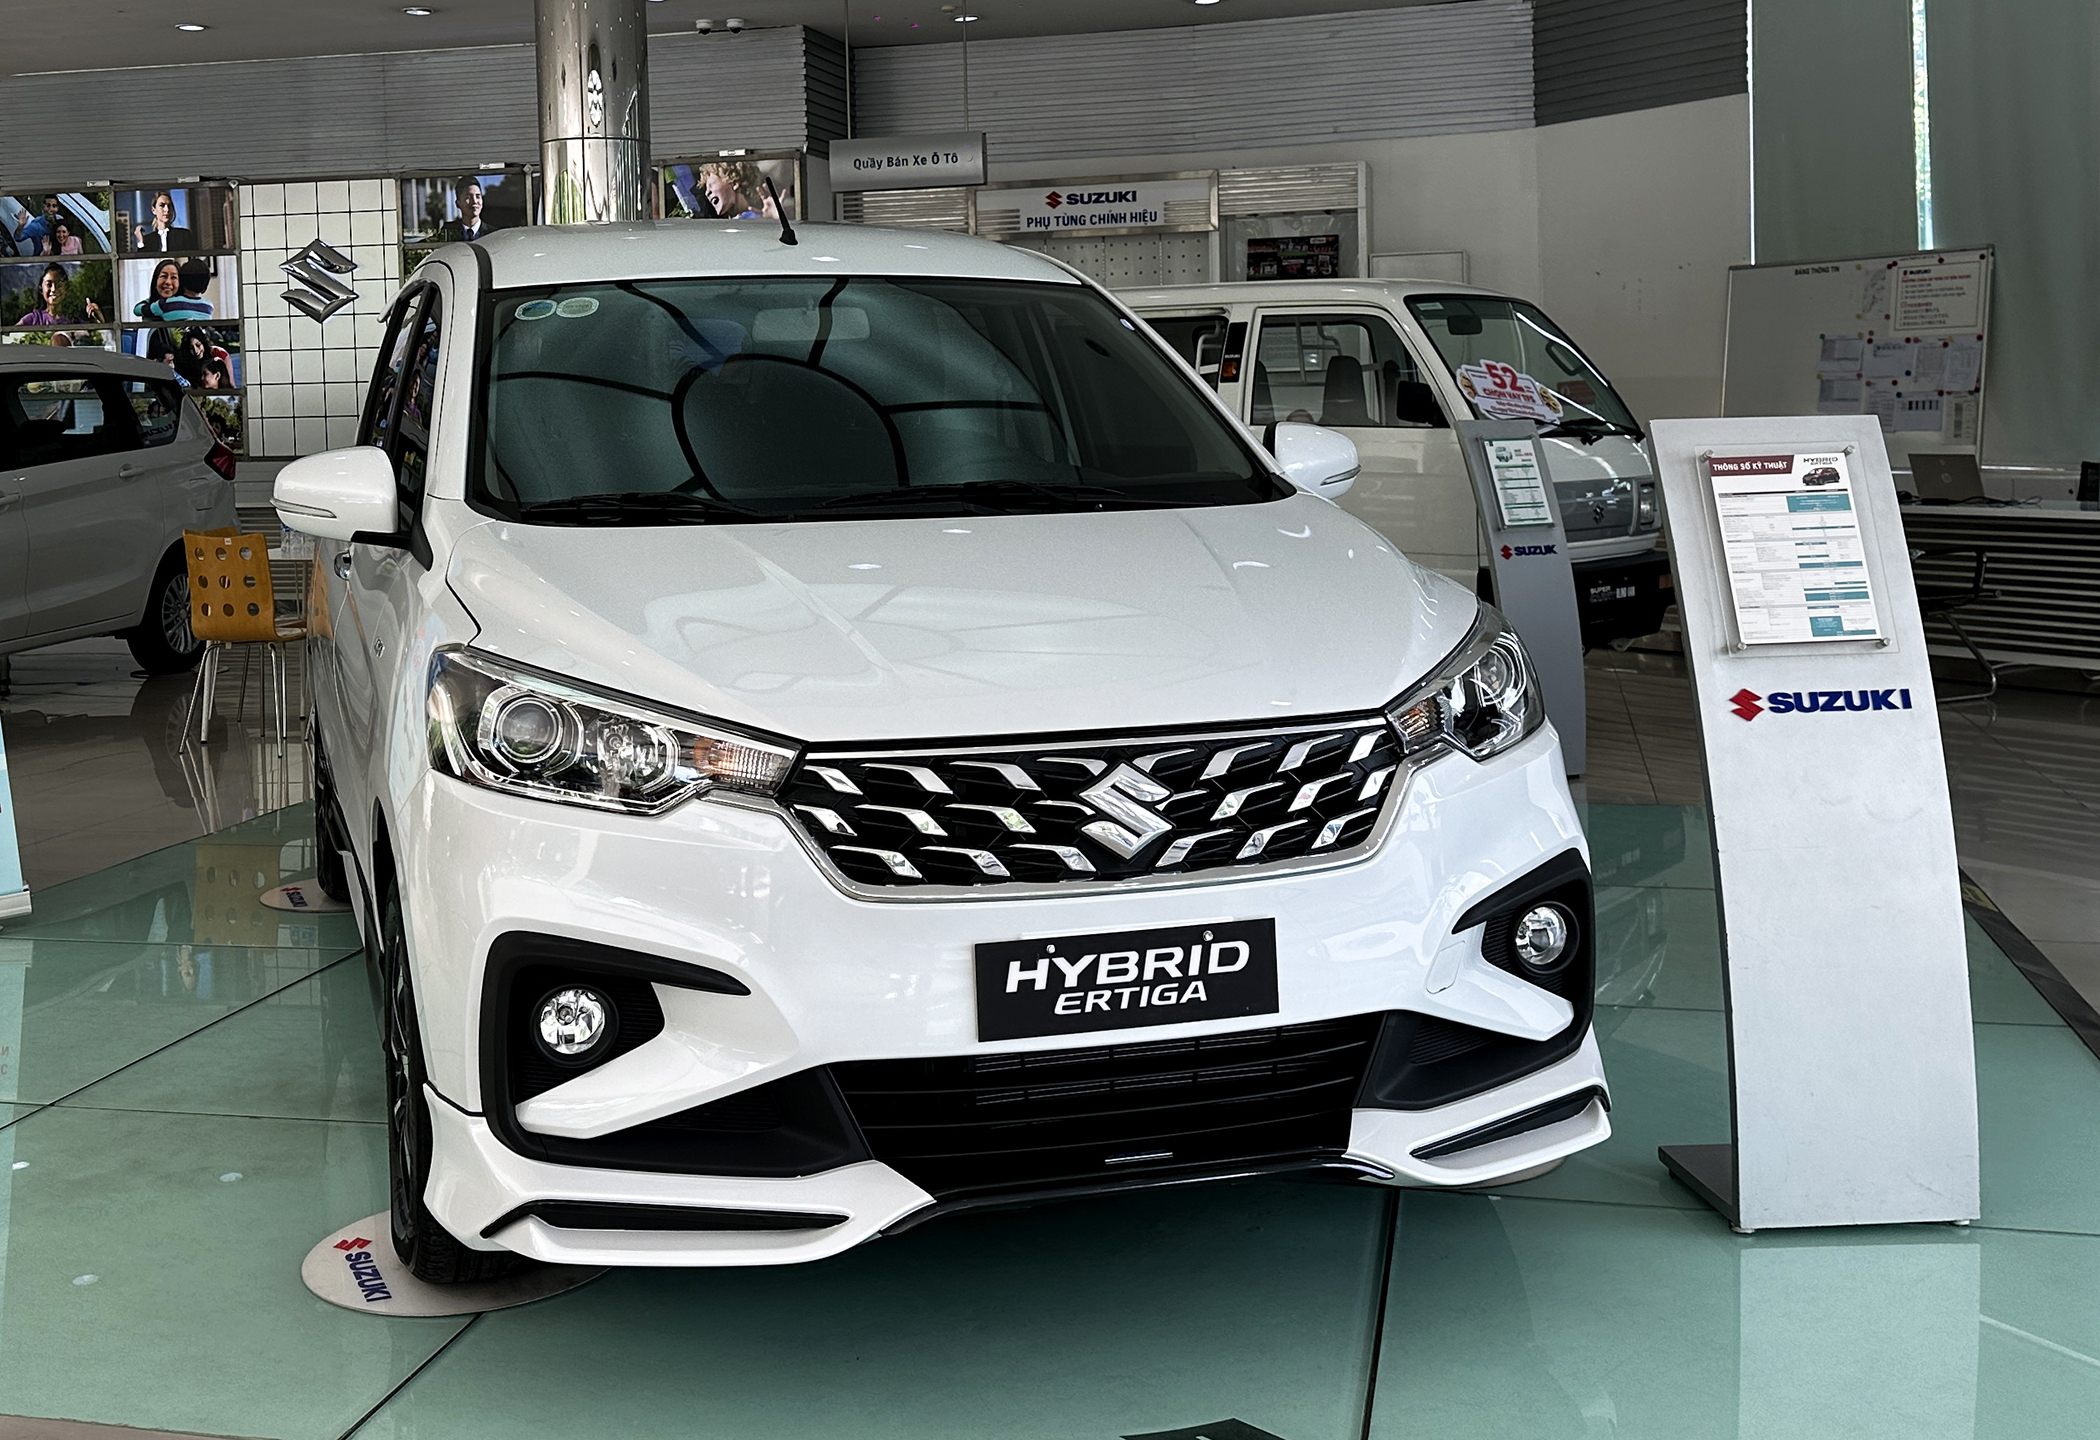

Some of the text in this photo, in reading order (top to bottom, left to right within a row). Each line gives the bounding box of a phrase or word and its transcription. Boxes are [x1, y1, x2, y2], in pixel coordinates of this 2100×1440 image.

[853, 156, 883, 170] Quầy
[886, 156, 909, 168] Bán
[912, 155, 927, 166] Xe
[943, 152, 959, 164] Tô
[1066, 190, 1137, 206] SUZUKI
[1026, 208, 1158, 230] PHỤ TÙNG CHÍNH HIỆU
[1484, 363, 1525, 392] 52
[1712, 462, 1739, 472] THÔNG
[1740, 461, 1751, 471] SỐ
[1764, 461, 1788, 470] THUẬT
[1767, 688, 1913, 714] SUZUKI
[1005, 940, 1250, 993] HYBRID
[1053, 980, 1208, 1016] ERTIGA
[344, 1251, 393, 1303] SUZUKI
